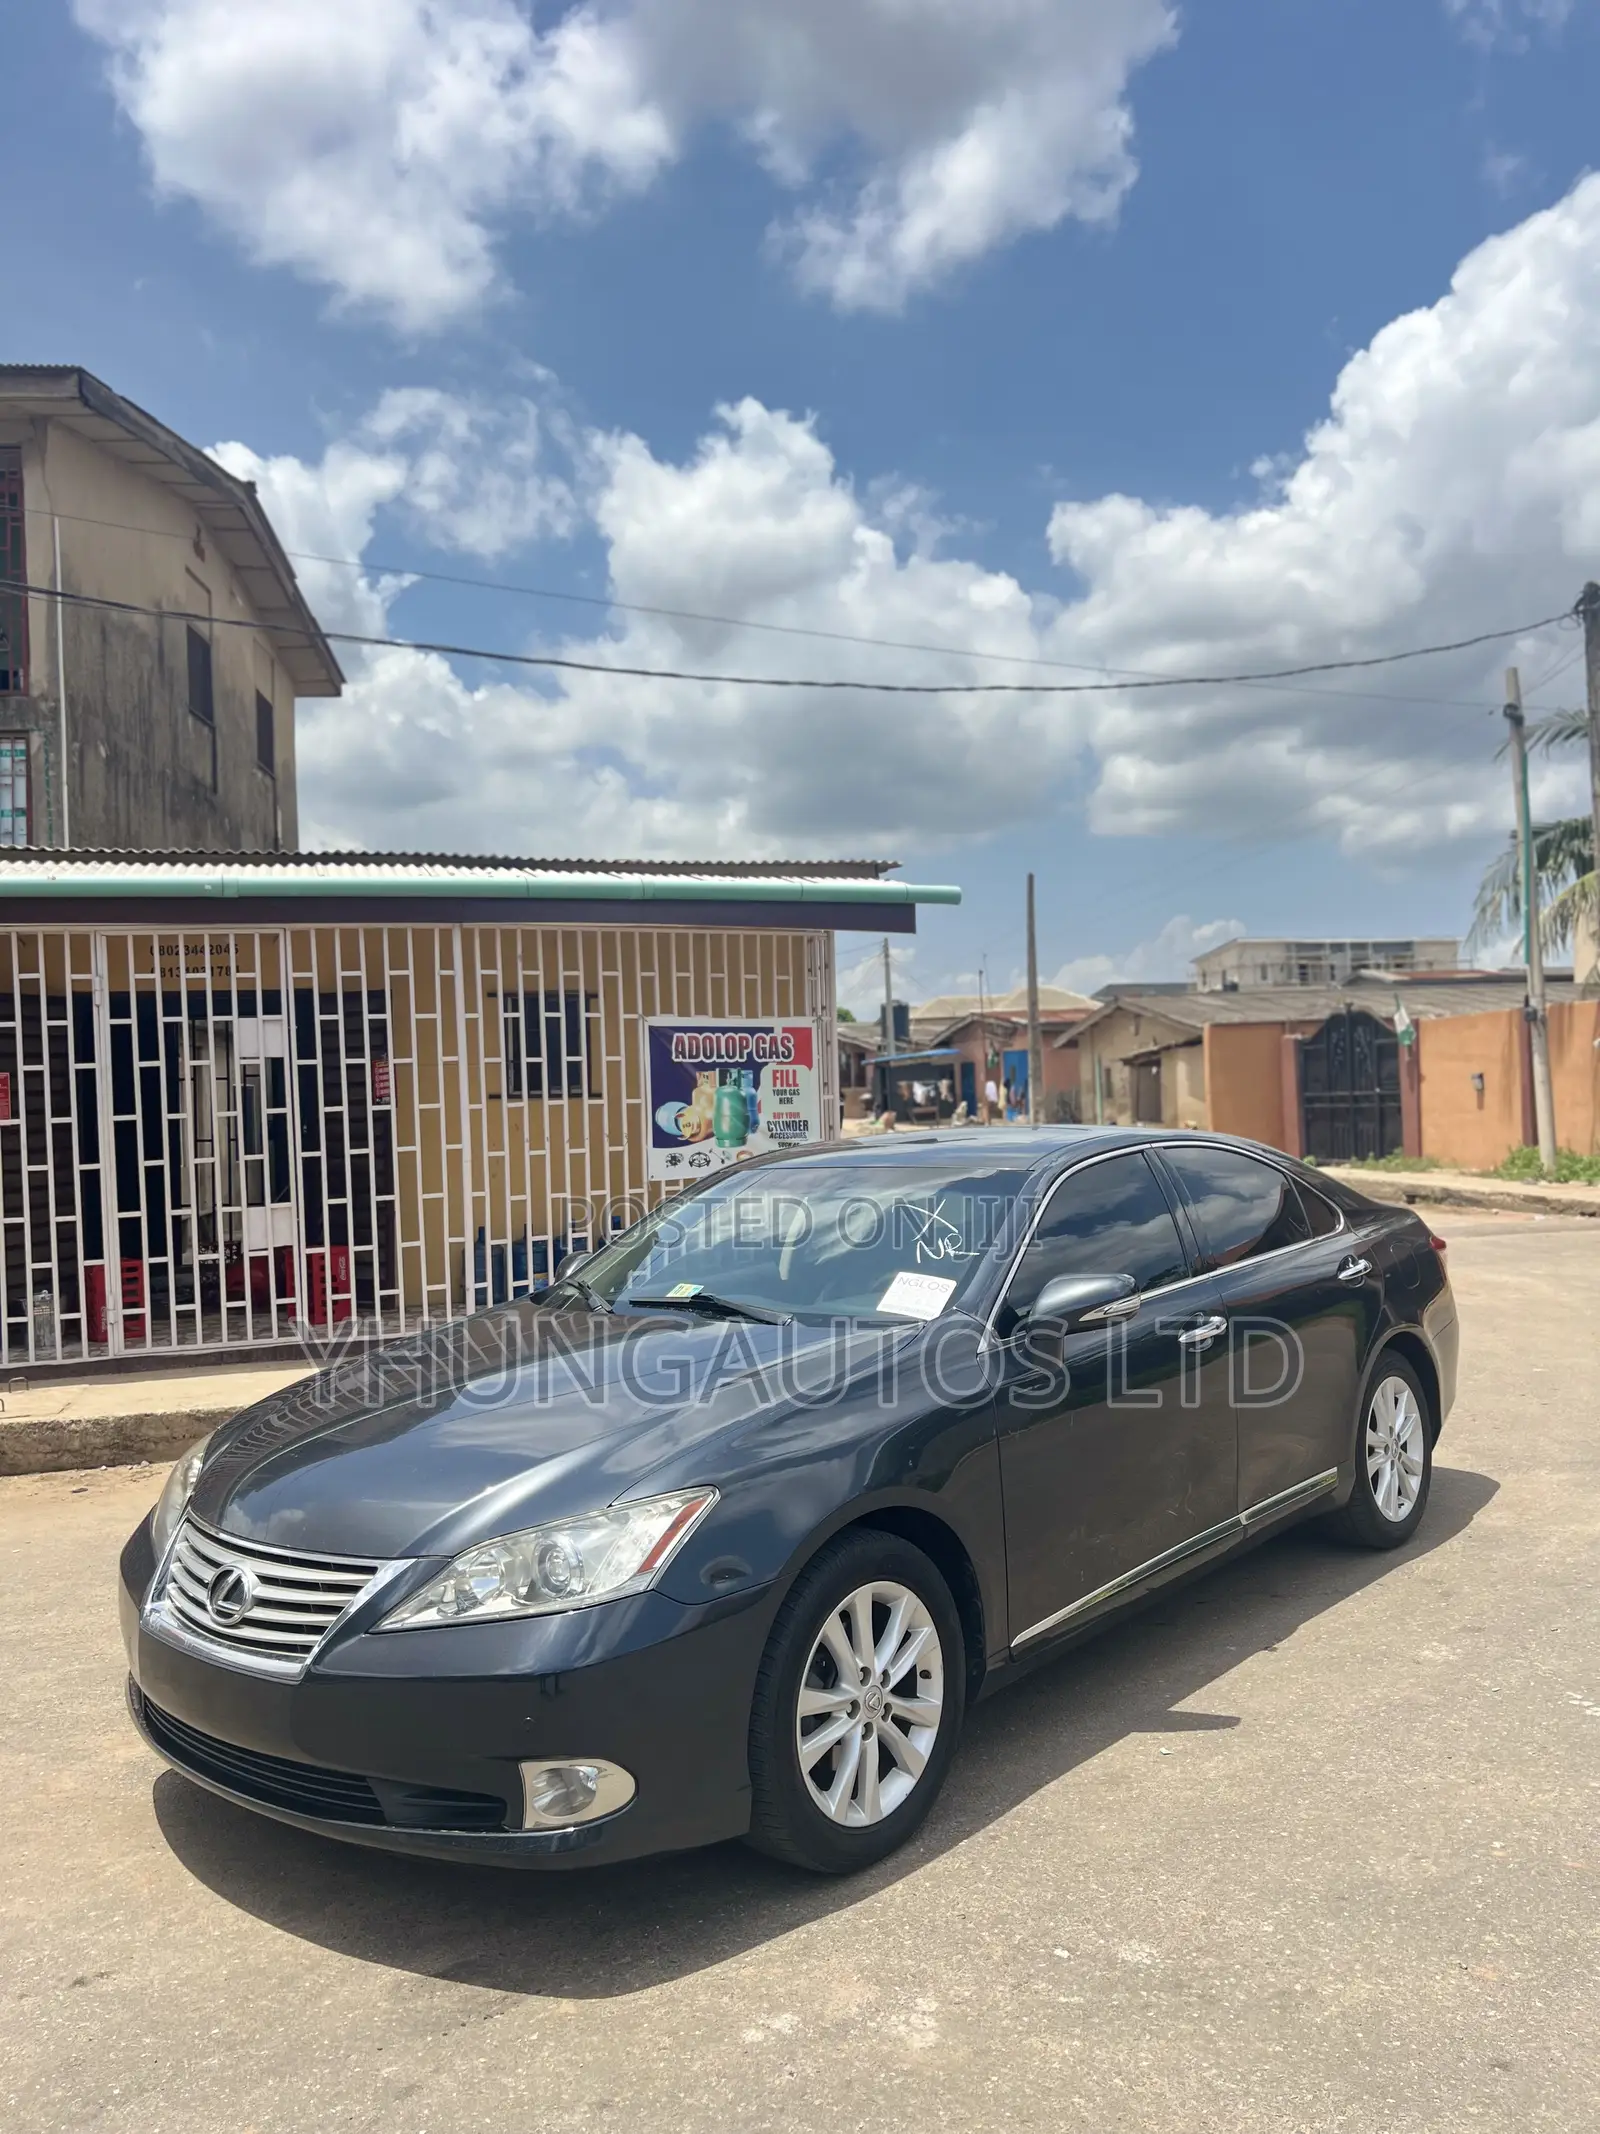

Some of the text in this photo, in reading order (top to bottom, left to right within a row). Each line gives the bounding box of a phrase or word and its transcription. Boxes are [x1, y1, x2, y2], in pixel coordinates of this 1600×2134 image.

[673, 1032, 794, 1062] ADOLOP GAS
[772, 1069, 799, 1088] FILL
[772, 1088, 800, 1096] YOUR GAS
[778, 1097, 794, 1105] HERE
[773, 1112, 784, 1120] BUY
[766, 1120, 809, 1132] CYLINDER
[769, 1131, 807, 1139] ACCESSORIES
